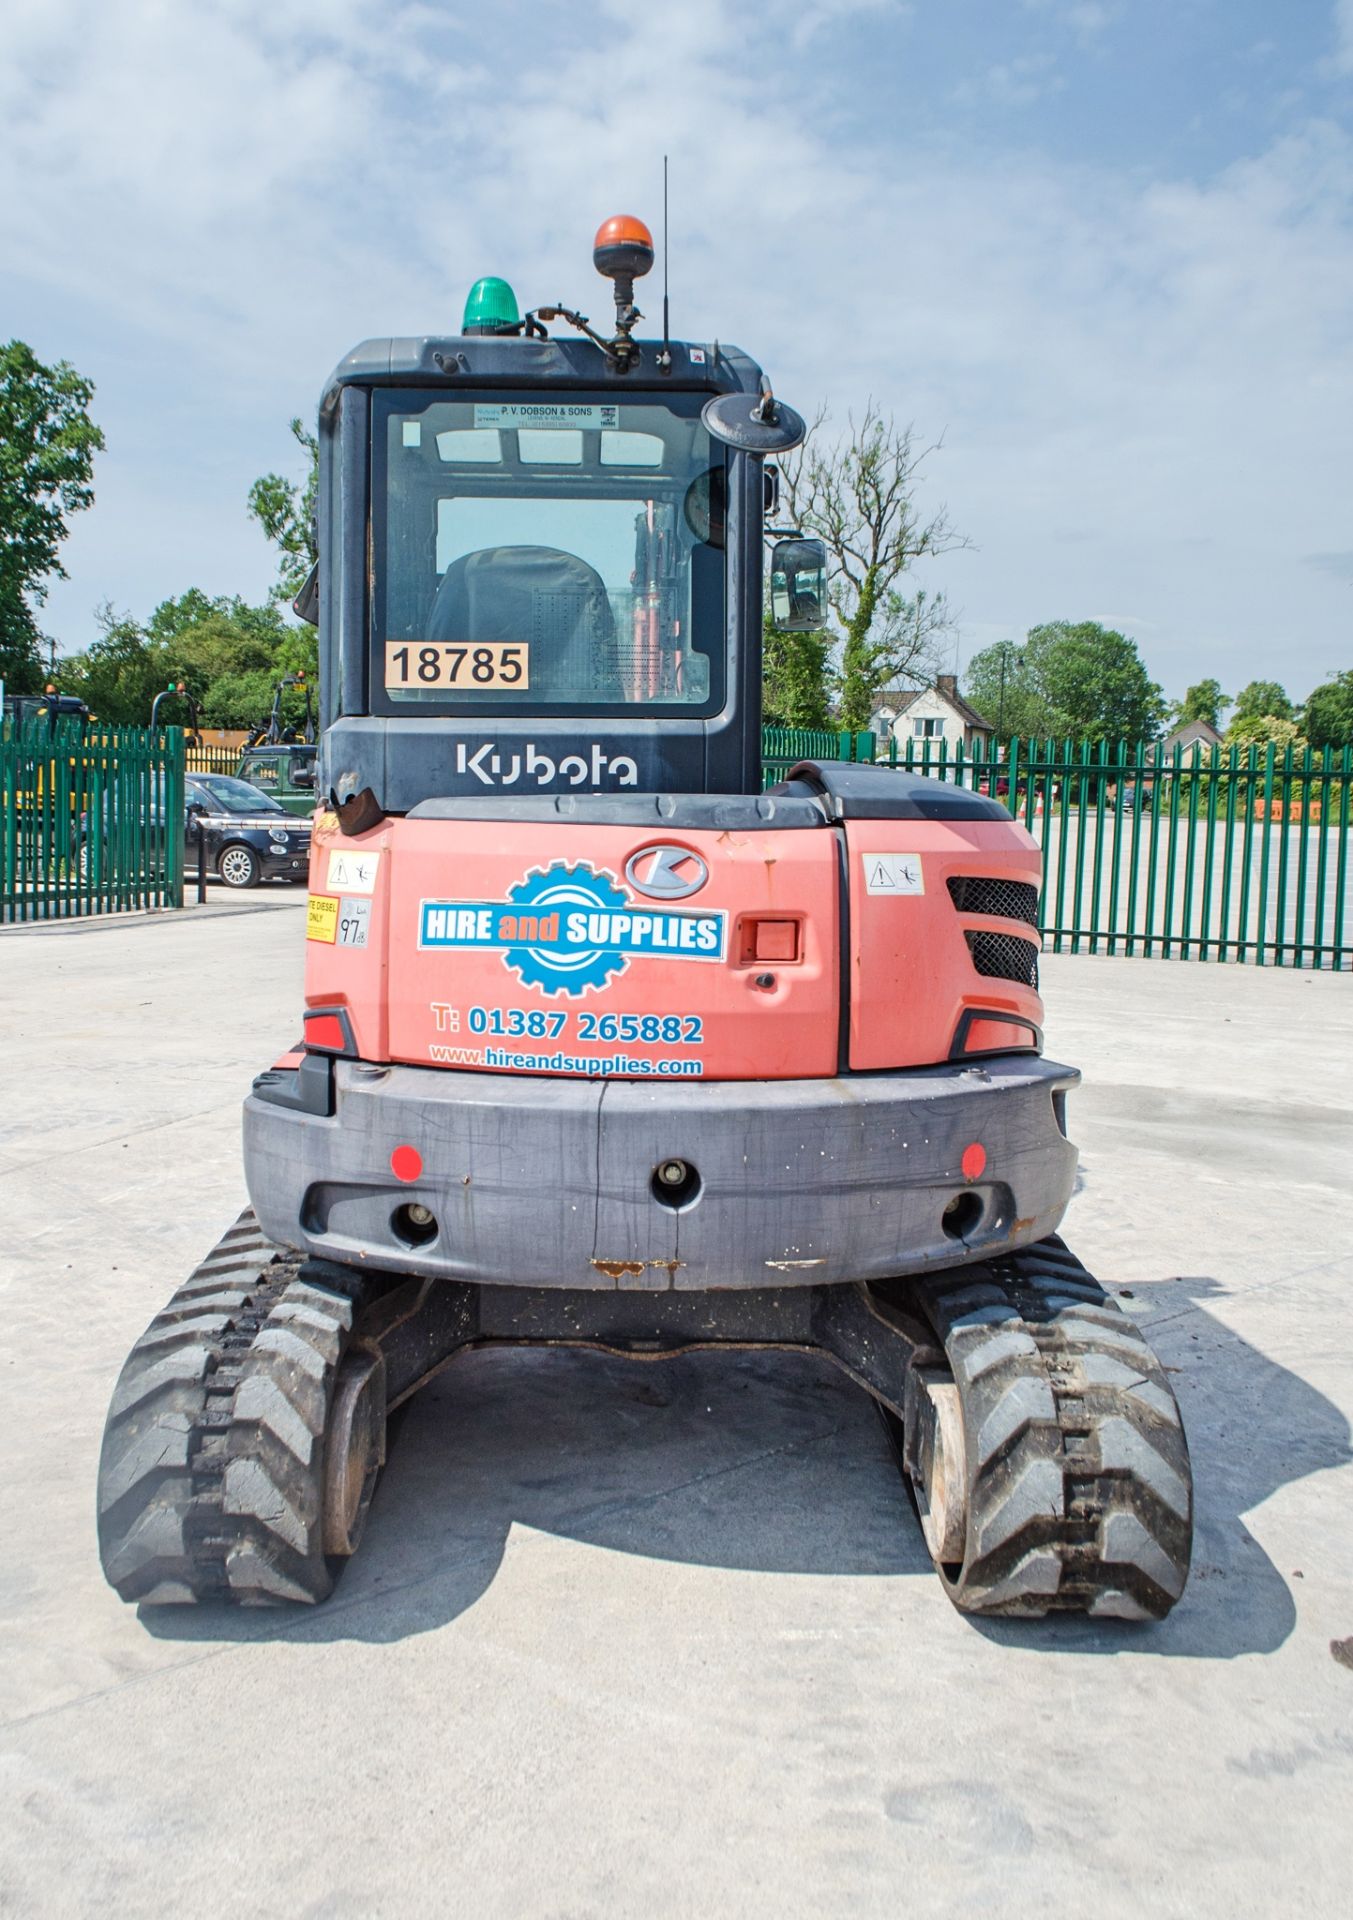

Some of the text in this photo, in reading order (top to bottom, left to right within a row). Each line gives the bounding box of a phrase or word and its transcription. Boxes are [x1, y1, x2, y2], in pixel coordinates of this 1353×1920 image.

[520, 407, 558, 416] DOBSON
[559, 407, 566, 415] &
[568, 407, 592, 416] SONS
[392, 647, 522, 683] 18785
[456, 743, 638, 785] Kubota
[308, 912, 323, 923] ONLY
[316, 901, 337, 913] DIESEL
[341, 919, 359, 943] 97
[426, 909, 719, 950] HIRE and SUPPLIES
[430, 1003, 703, 1043] T: 01387 265882
[429, 1043, 704, 1075] www.hireandsupplies.com
